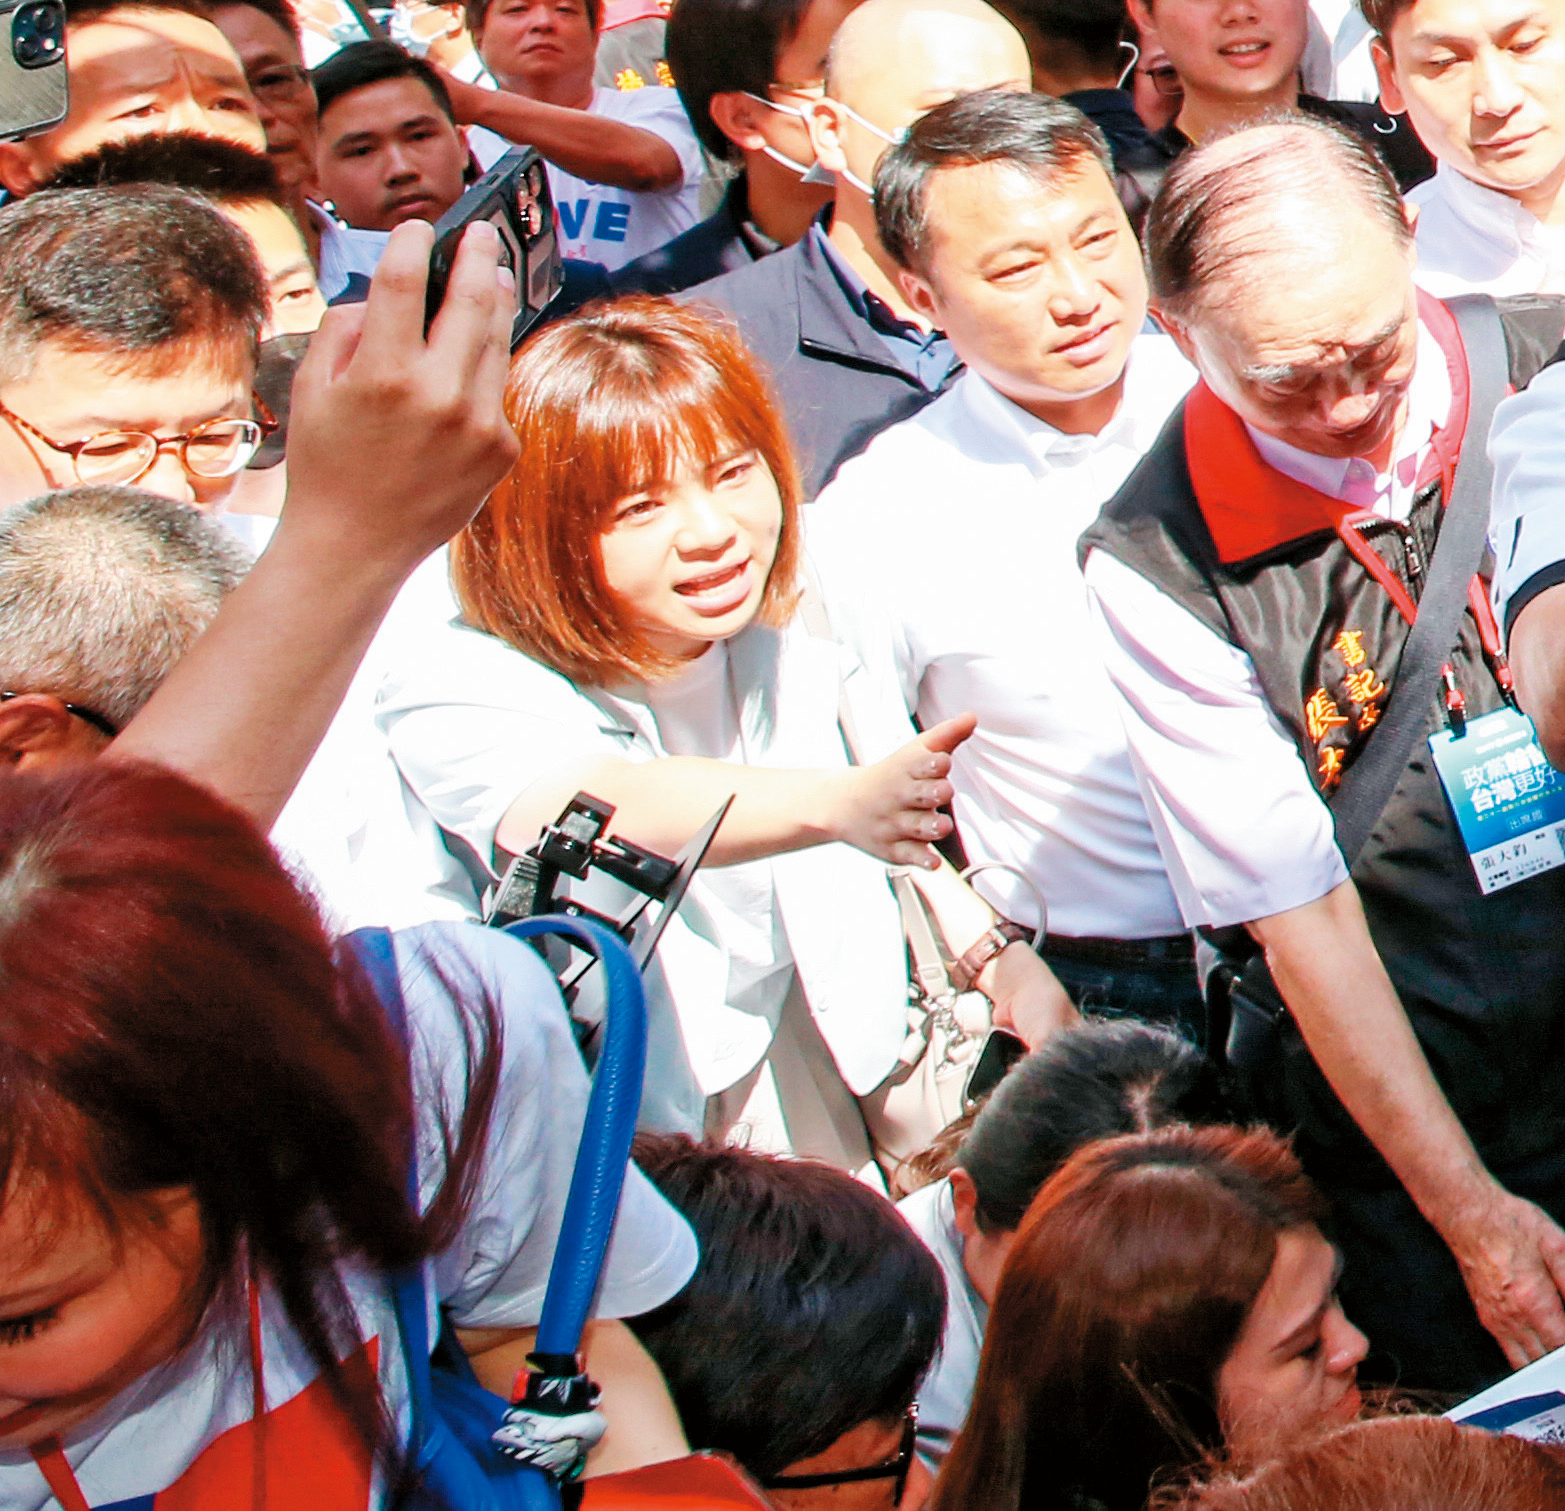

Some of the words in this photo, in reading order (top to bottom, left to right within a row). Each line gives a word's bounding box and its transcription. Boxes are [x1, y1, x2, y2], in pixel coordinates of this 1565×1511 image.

[557, 198, 631, 242] VE
[1470, 766, 1557, 813] 台灣更好
